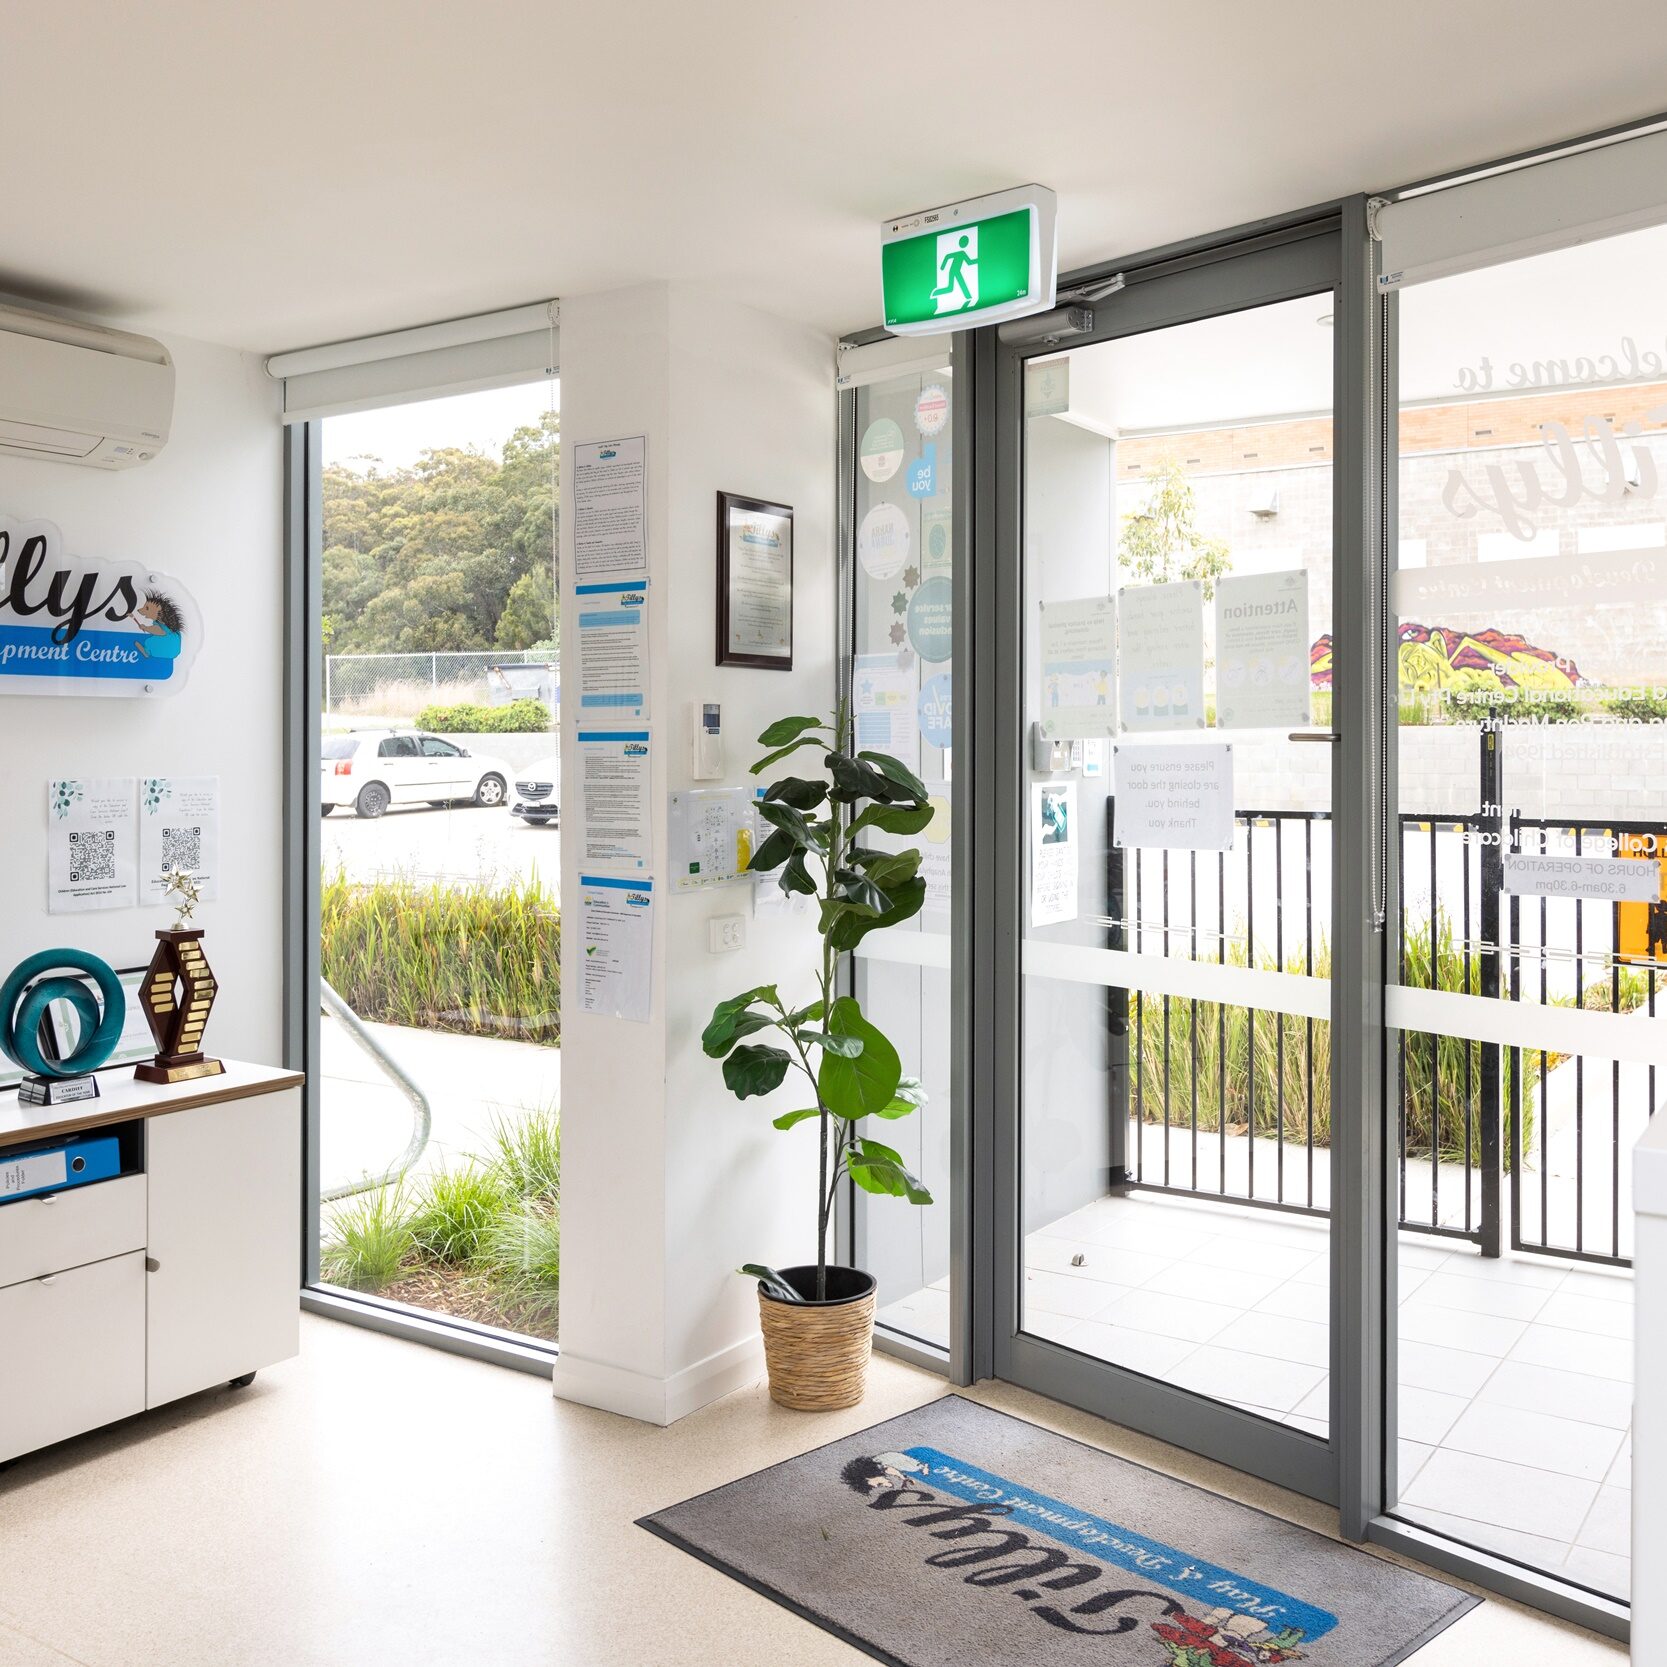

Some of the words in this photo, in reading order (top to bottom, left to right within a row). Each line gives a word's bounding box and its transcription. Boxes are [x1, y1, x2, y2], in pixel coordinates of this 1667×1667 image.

[0, 530, 138, 645] lys
[76, 640, 139, 664] Centre
[931, 1466, 1004, 1500] Centre
[1000, 1497, 1174, 1570] Development
[866, 1489, 1187, 1637] Tillys
[1168, 1565, 1204, 1582] &
[1206, 1580, 1288, 1618] Play
